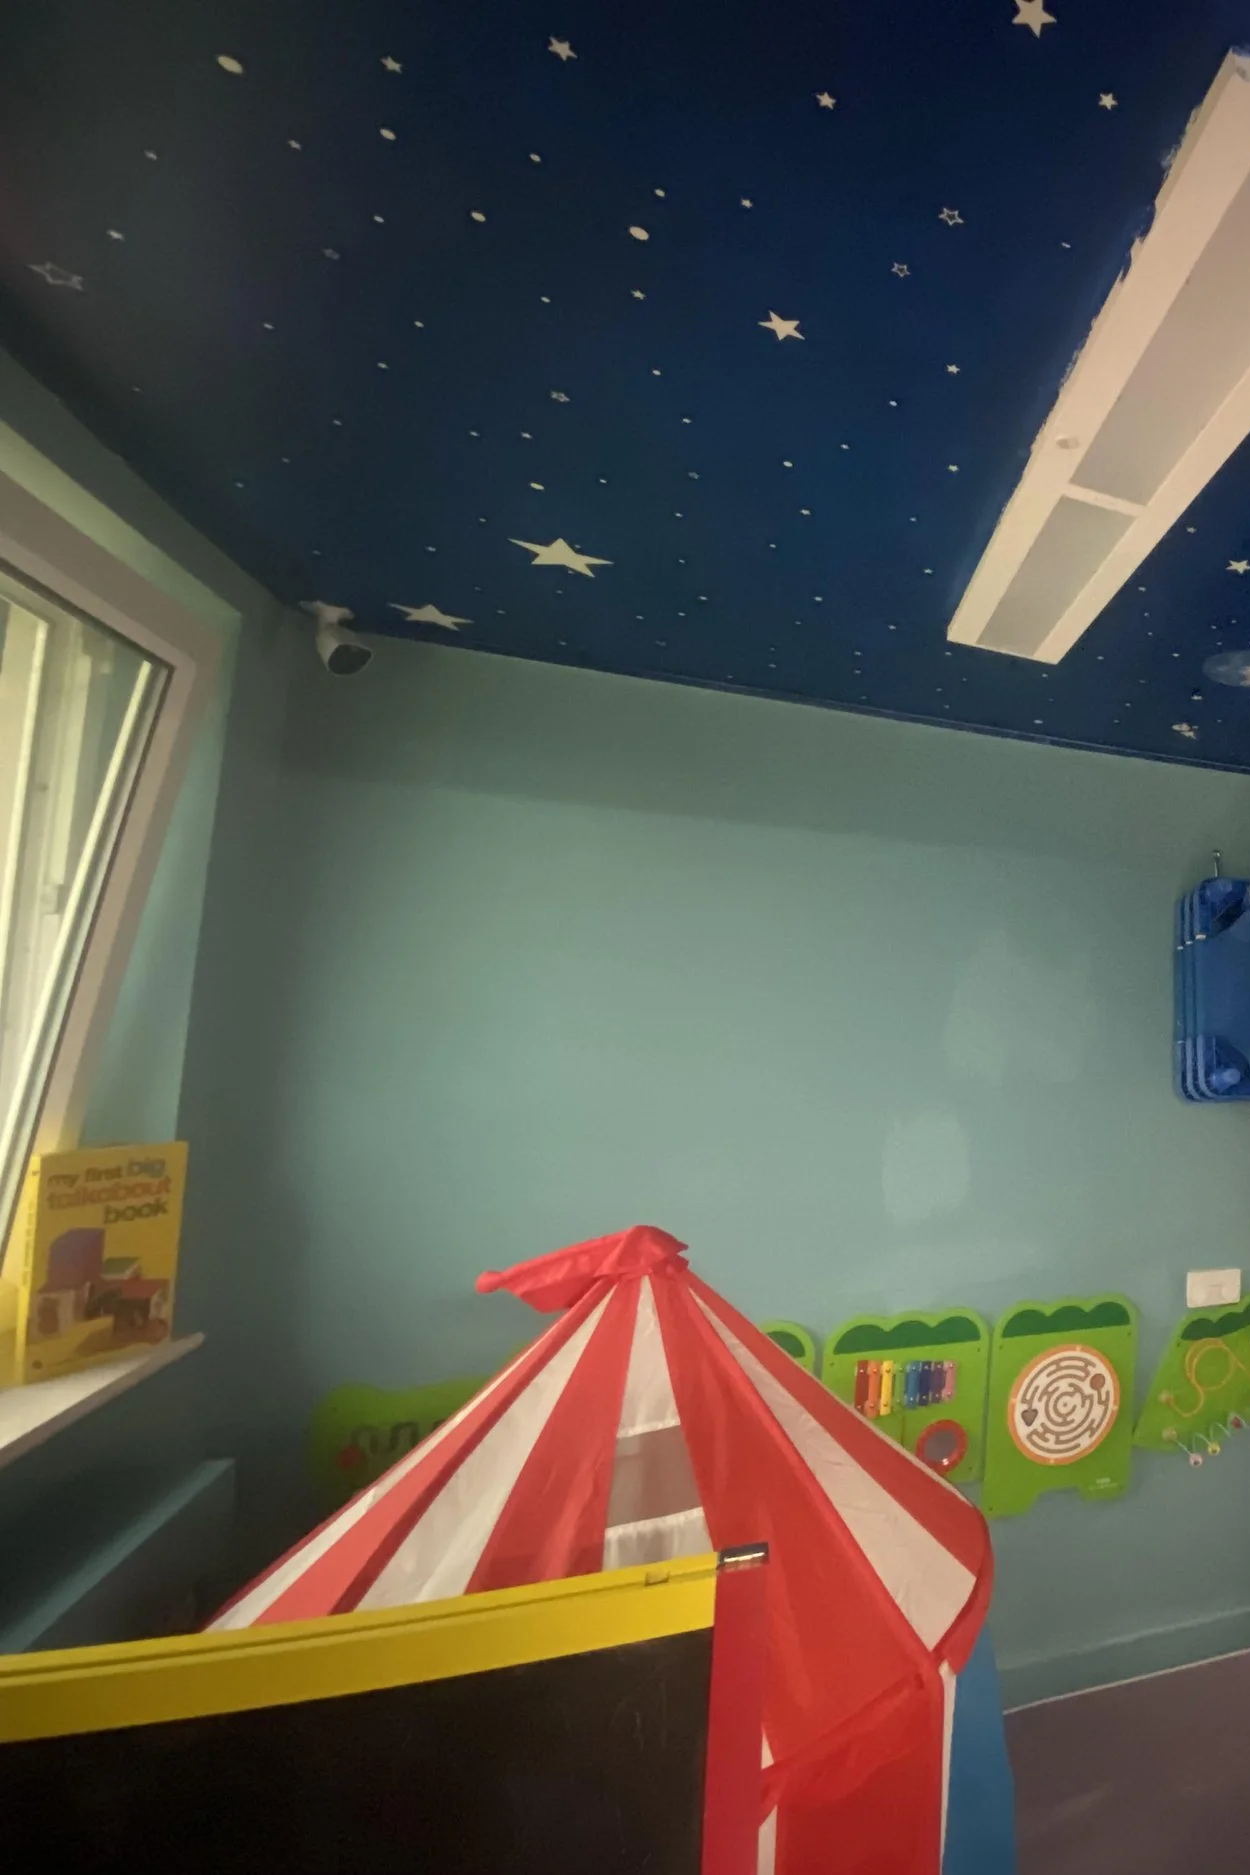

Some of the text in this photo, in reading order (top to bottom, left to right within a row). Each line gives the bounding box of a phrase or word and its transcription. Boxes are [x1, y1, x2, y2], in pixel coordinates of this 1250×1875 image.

[47, 1157, 165, 1188] my first big
[103, 1198, 168, 1224] book
